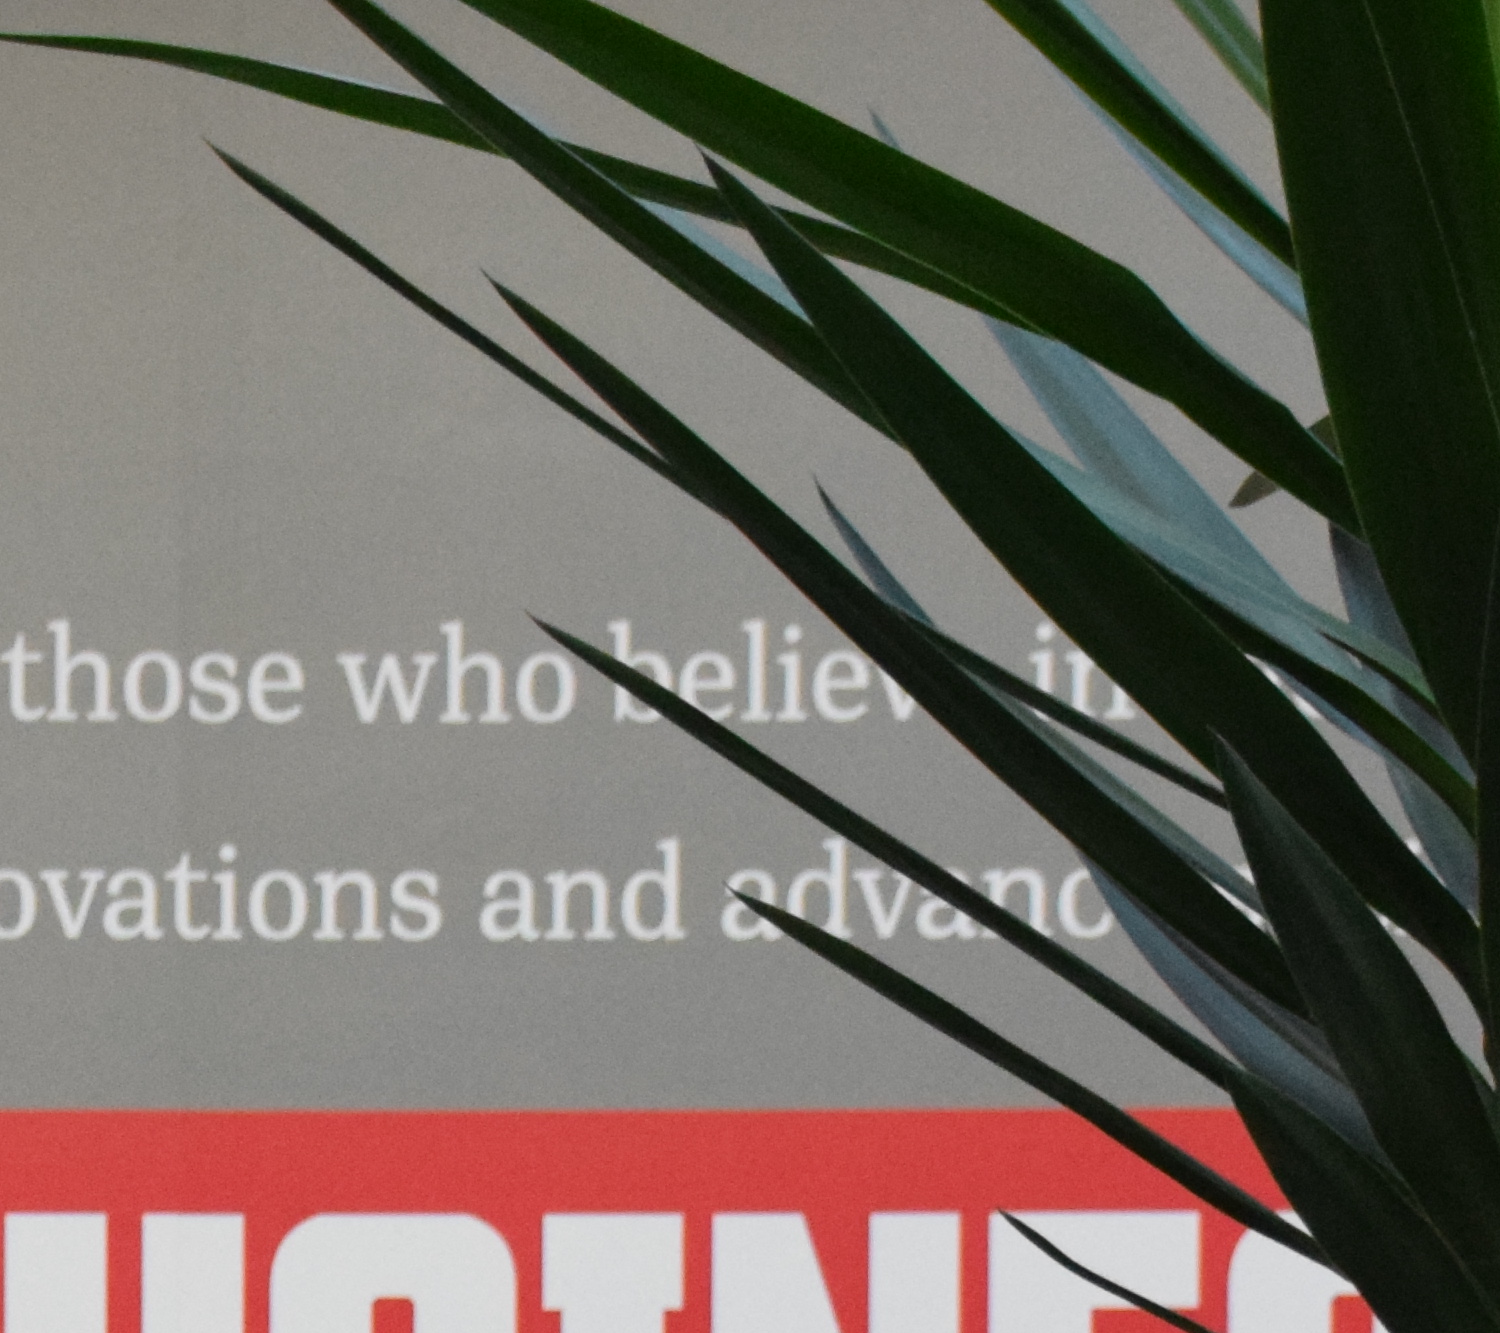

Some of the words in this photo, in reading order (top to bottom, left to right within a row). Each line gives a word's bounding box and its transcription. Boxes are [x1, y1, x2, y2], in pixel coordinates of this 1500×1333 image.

[1, 619, 304, 724] those
[337, 620, 576, 724] who
[479, 837, 685, 942] and
[720, 836, 1116, 942] advanc
